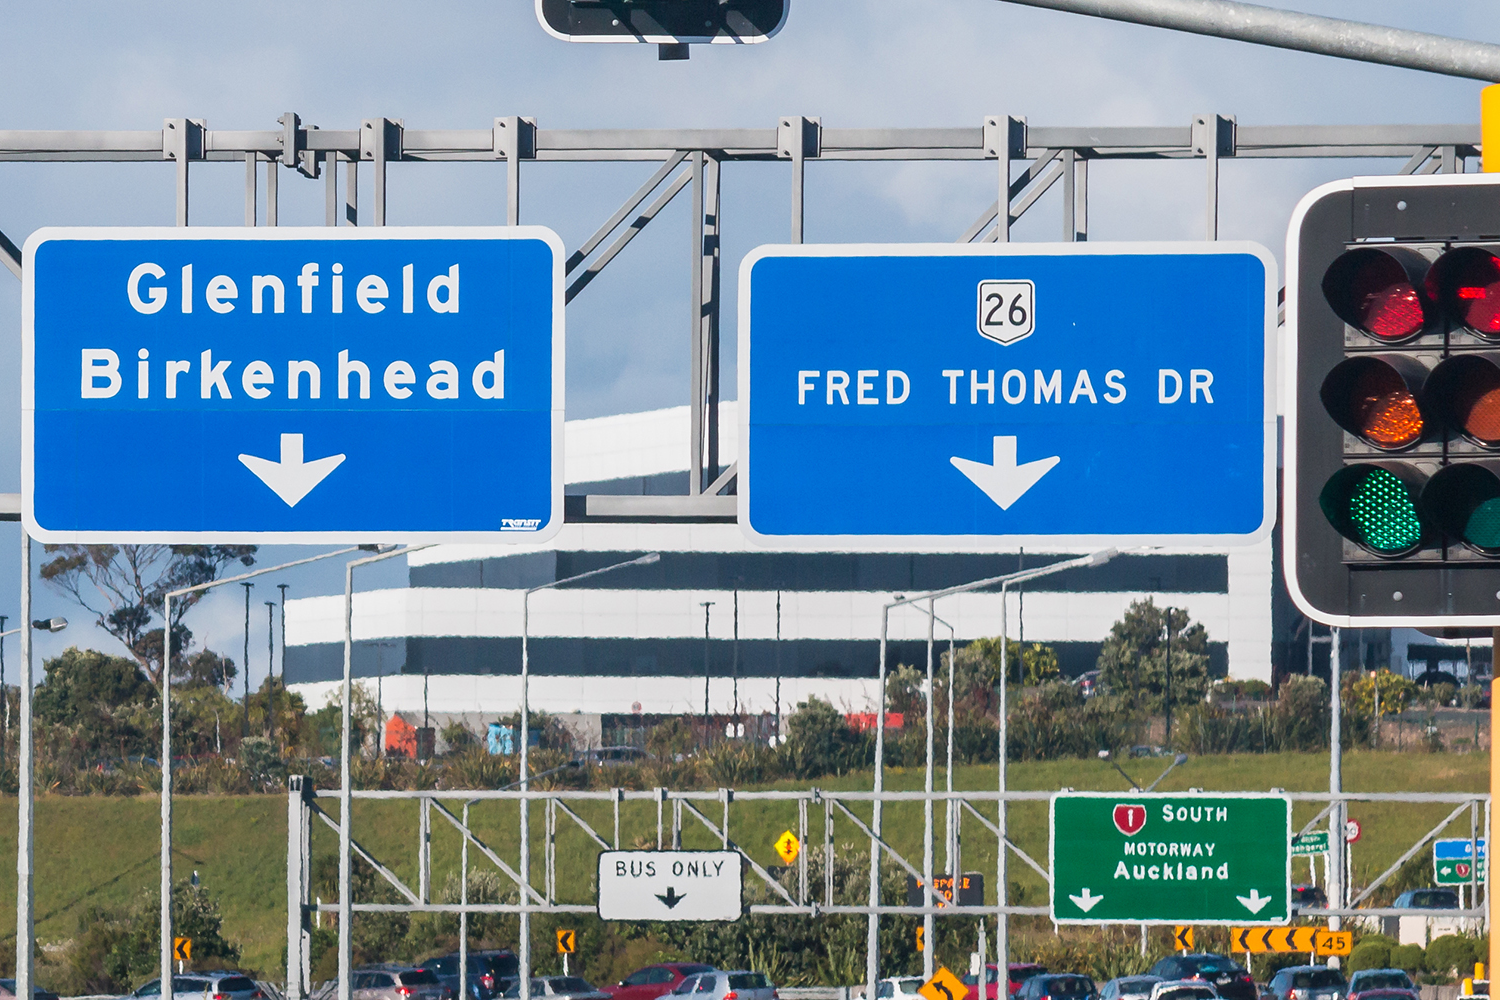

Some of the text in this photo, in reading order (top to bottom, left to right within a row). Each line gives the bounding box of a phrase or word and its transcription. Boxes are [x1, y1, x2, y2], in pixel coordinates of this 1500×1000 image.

[127, 262, 460, 315] Glenfield
[985, 292, 1027, 327] 26
[81, 347, 505, 399] Birkenhead
[798, 368, 1215, 405] FRED THOMAS DR
[1162, 804, 1228, 822] SOUTH
[1124, 842, 1215, 857] MOTORWAY
[616, 860, 724, 877] BUS ONLY
[1114, 861, 1228, 880] Auckland
[1322, 937, 1345, 950] 45
